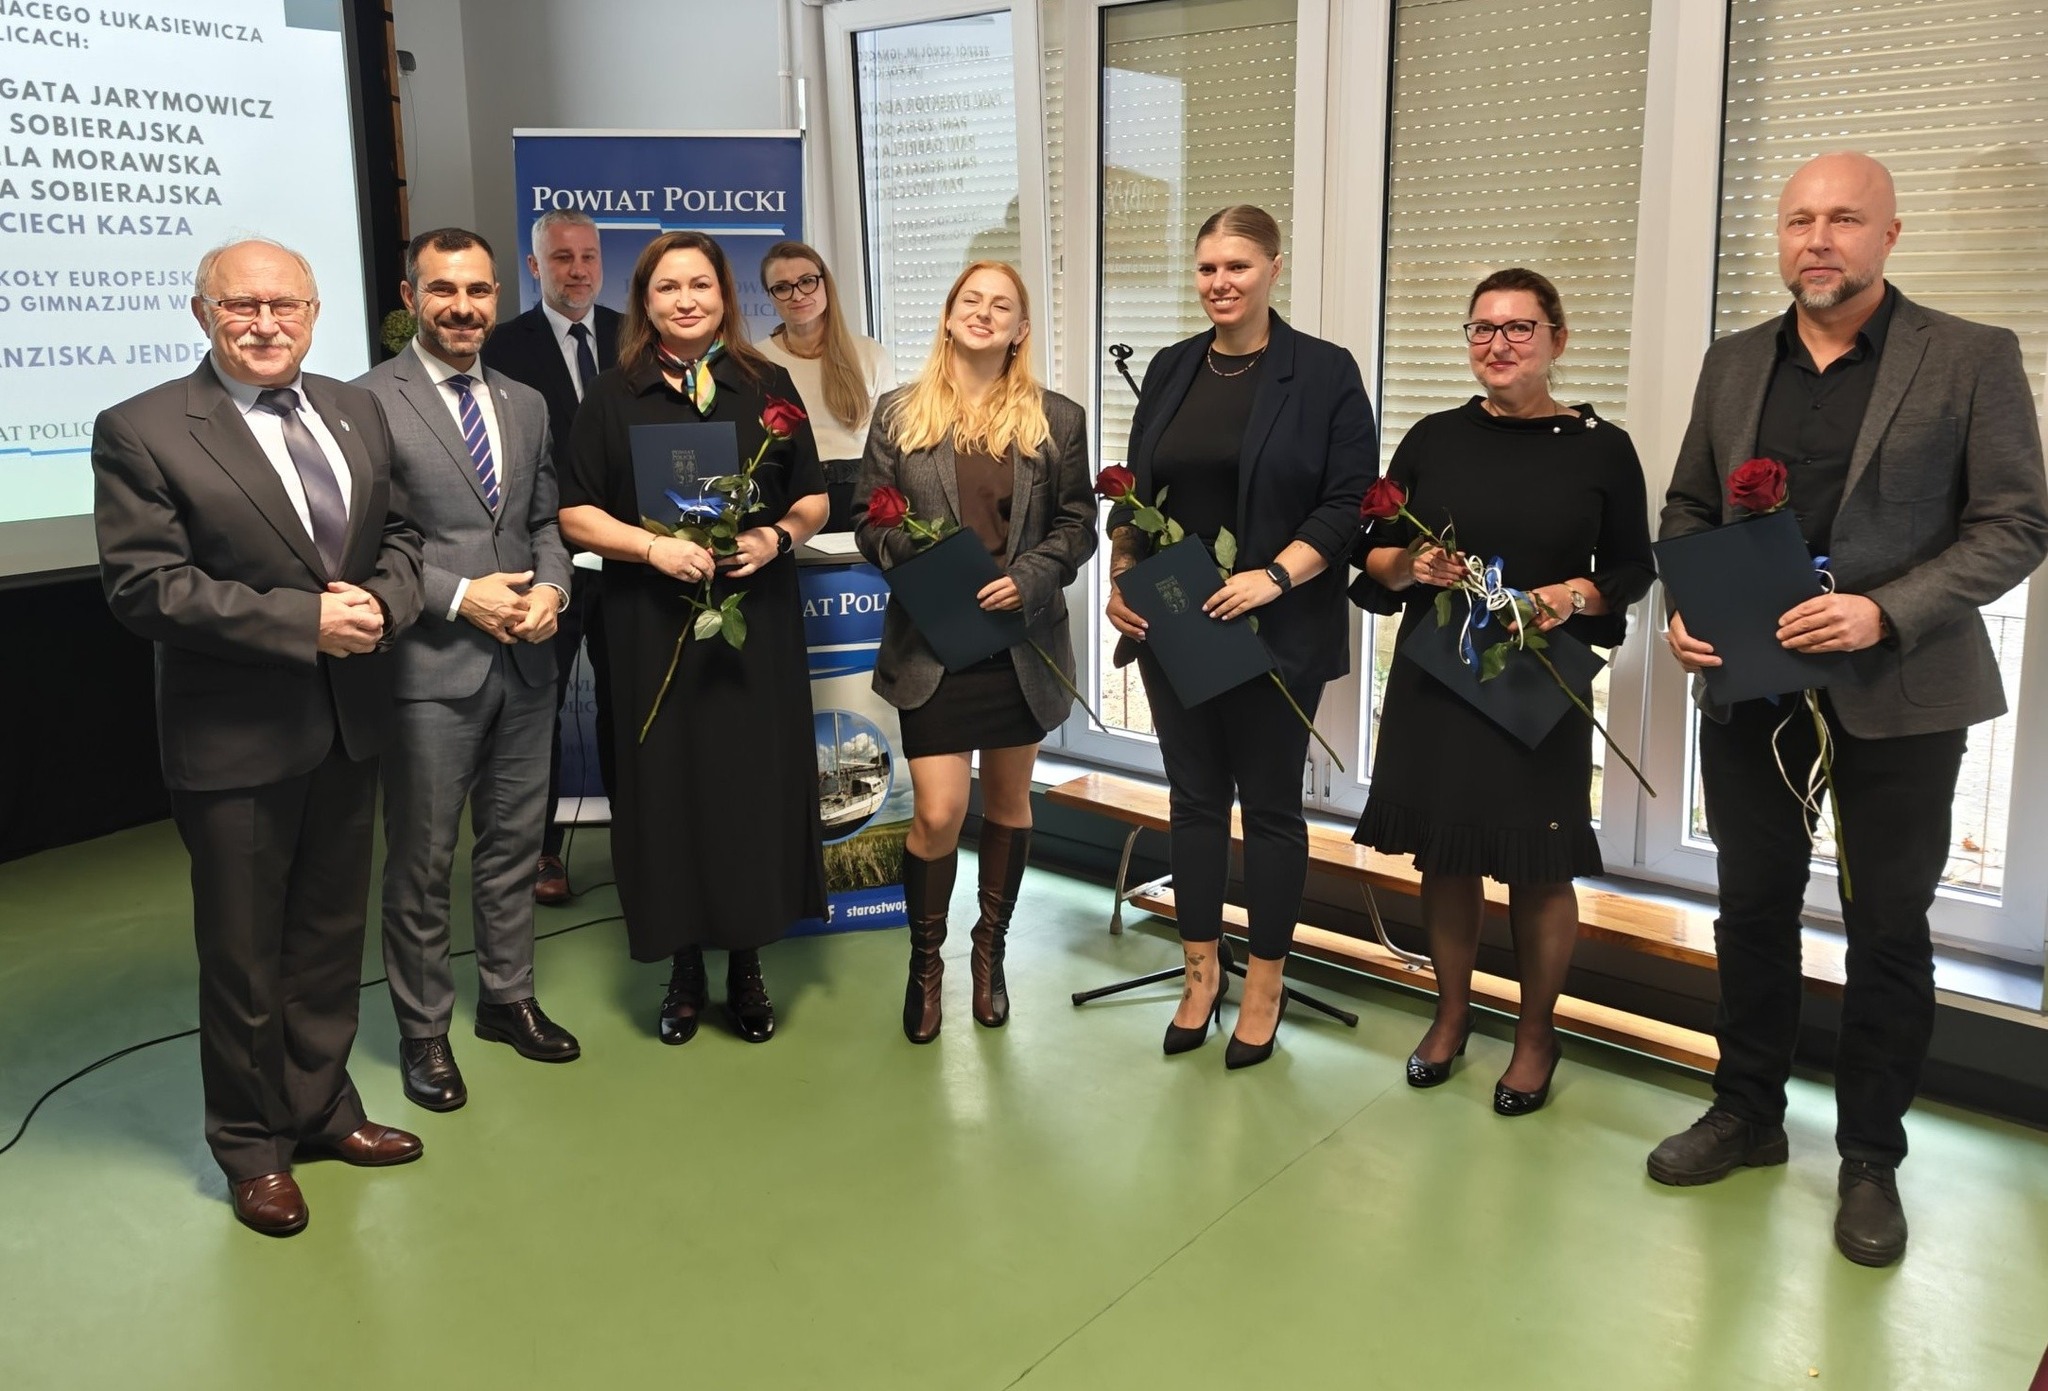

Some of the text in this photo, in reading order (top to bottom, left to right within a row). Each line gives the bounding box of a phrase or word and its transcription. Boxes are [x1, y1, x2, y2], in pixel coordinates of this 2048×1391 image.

[0, 25, 89, 49] ICACH:
[100, 10, 263, 43] ŁUKASIEWICZA
[91, 86, 274, 119] JARYMOWICZ
[10, 113, 204, 145] SOBIERAJSKA
[53, 148, 221, 176] MORAWSKA
[31, 179, 222, 206] SOBIERAJSKA
[532, 187, 786, 212] POWIAT POLICKI
[0, 212, 193, 236] CIECH KASZA
[21, 294, 161, 312] GIMNAZJUM
[171, 295, 188, 310] W
[0, 342, 205, 368] NZISKA JENDE
[803, 598, 834, 617] AT
